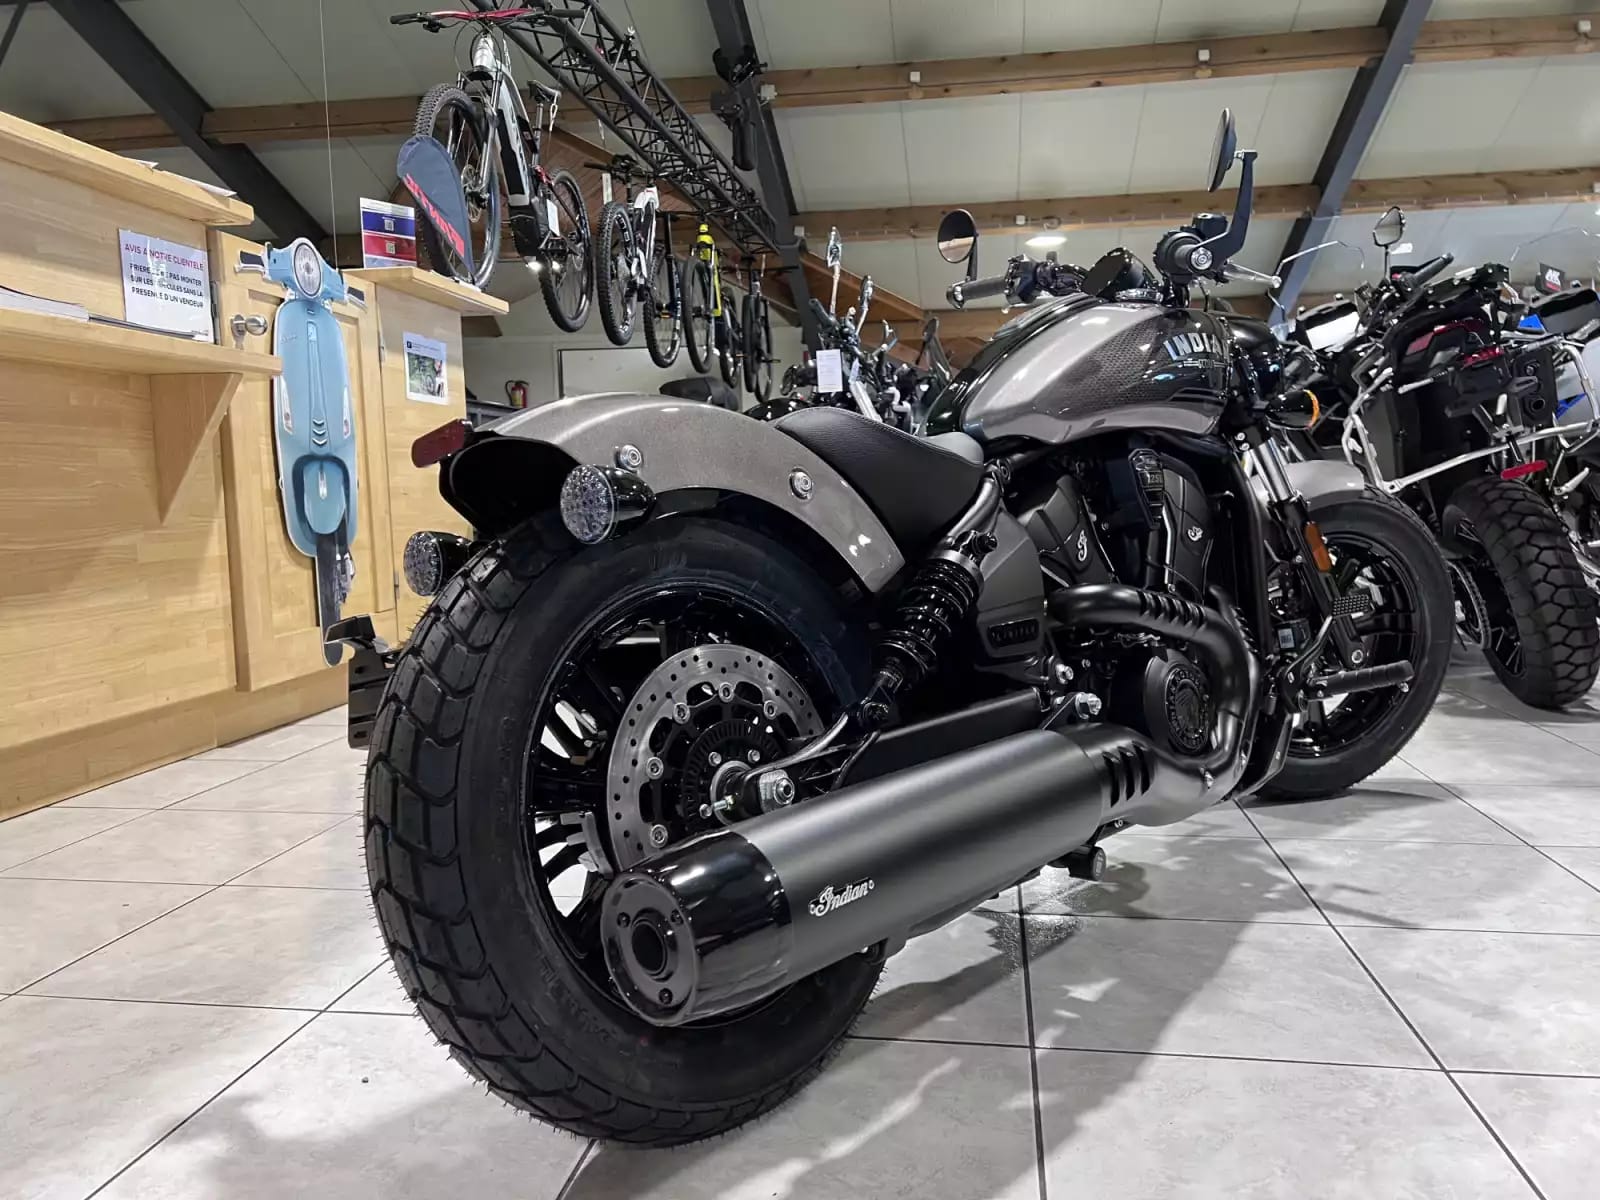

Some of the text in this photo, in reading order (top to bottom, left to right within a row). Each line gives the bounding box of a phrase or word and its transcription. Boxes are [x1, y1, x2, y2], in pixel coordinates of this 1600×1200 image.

[124, 243, 141, 255] AVIS
[143, 277, 154, 286] LES
[815, 881, 869, 917] Indian
